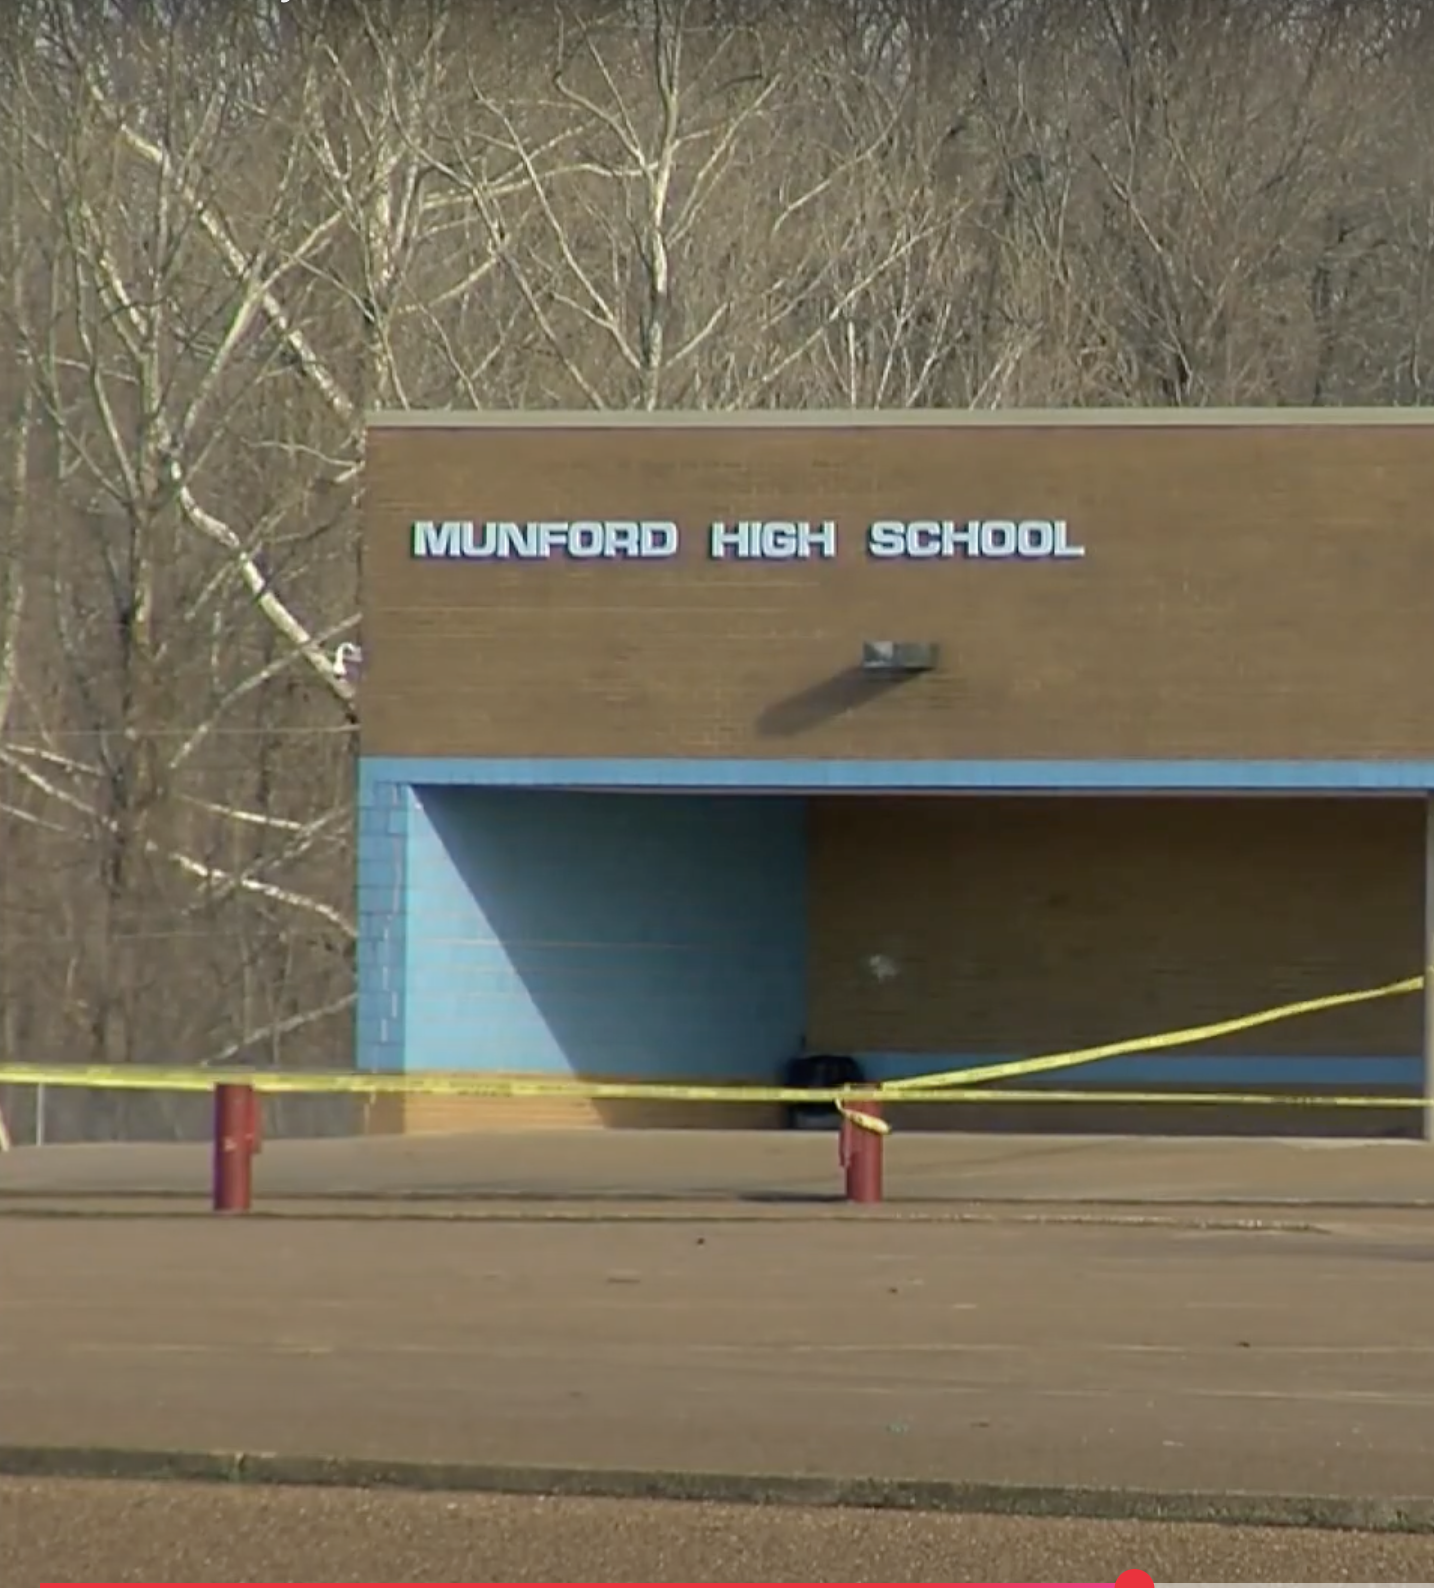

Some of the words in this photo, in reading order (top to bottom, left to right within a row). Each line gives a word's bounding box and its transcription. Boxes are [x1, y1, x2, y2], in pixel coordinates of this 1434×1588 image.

[411, 519, 678, 557] MUNFORD
[709, 519, 836, 557] HIGH
[867, 519, 1086, 557] SCHOOL
